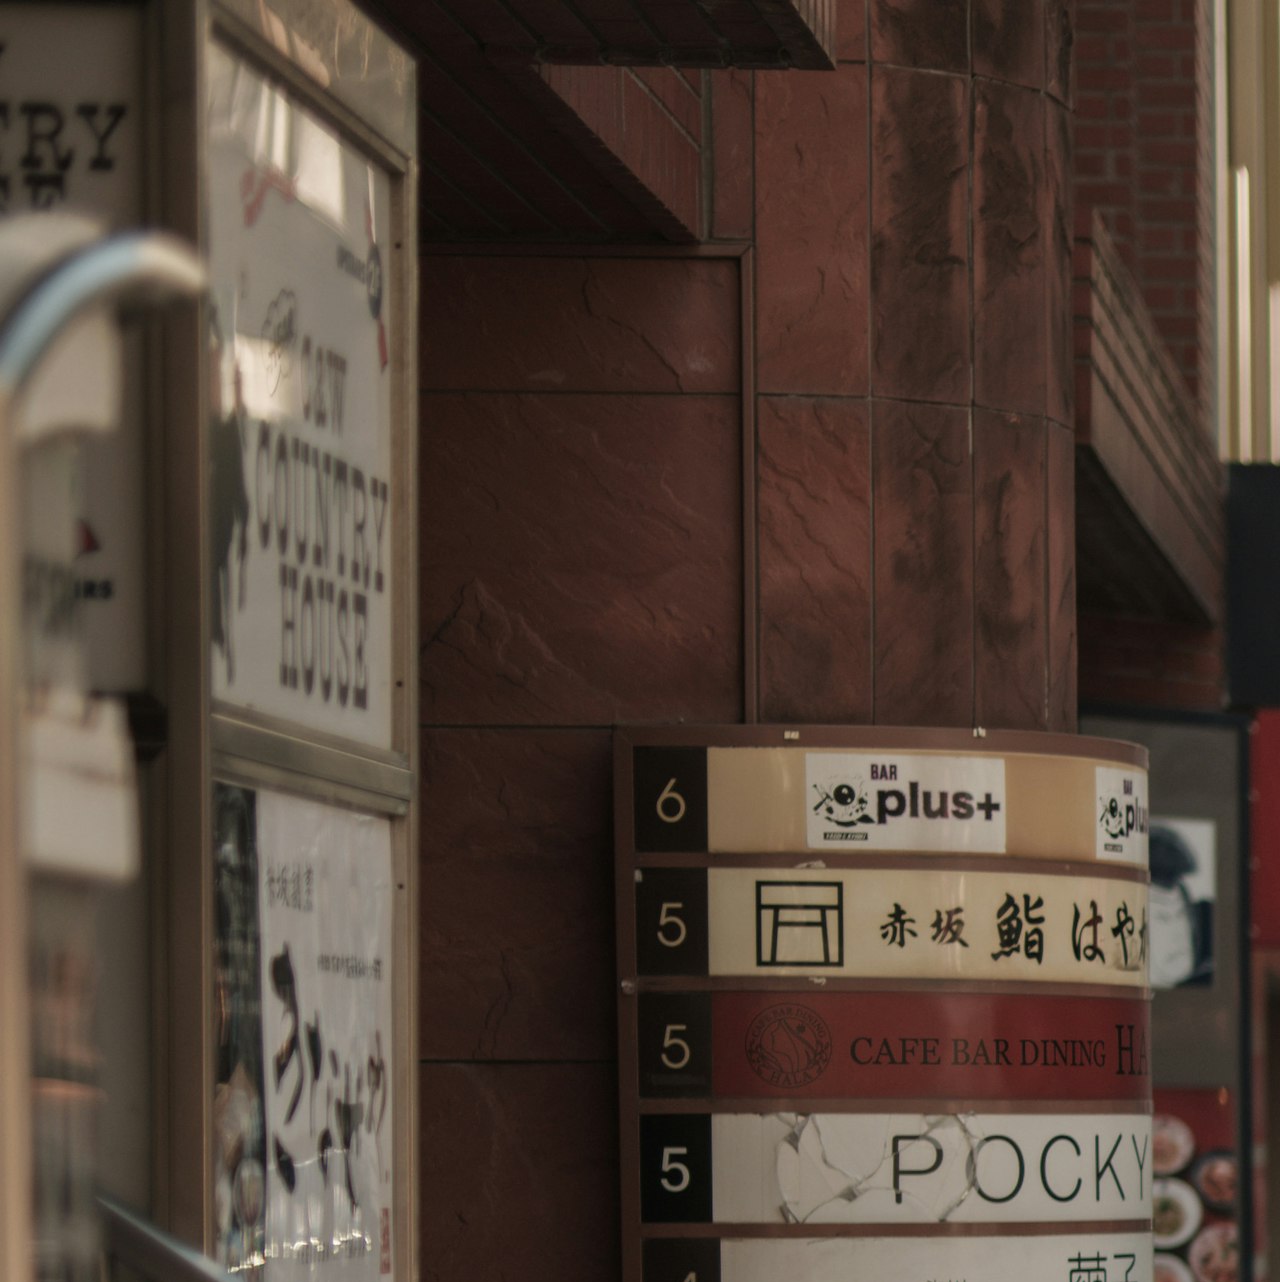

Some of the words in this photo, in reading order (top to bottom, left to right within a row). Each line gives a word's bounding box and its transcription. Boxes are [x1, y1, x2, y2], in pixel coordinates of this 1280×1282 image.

[256, 424, 388, 594] COUNTRY
[279, 560, 368, 711] HOUSE
[870, 764, 898, 781] BAR
[656, 778, 686, 823] 6
[876, 781, 1000, 825] plus+
[657, 902, 687, 947] 5
[879, 902, 970, 948] 赤坂
[991, 893, 1045, 965] 鮨
[661, 1024, 690, 1069] 5
[849, 1036, 941, 1066] CAFE
[951, 1038, 1014, 1066] BAR
[1020, 1039, 1106, 1068] DINING
[660, 1147, 690, 1192] 5
